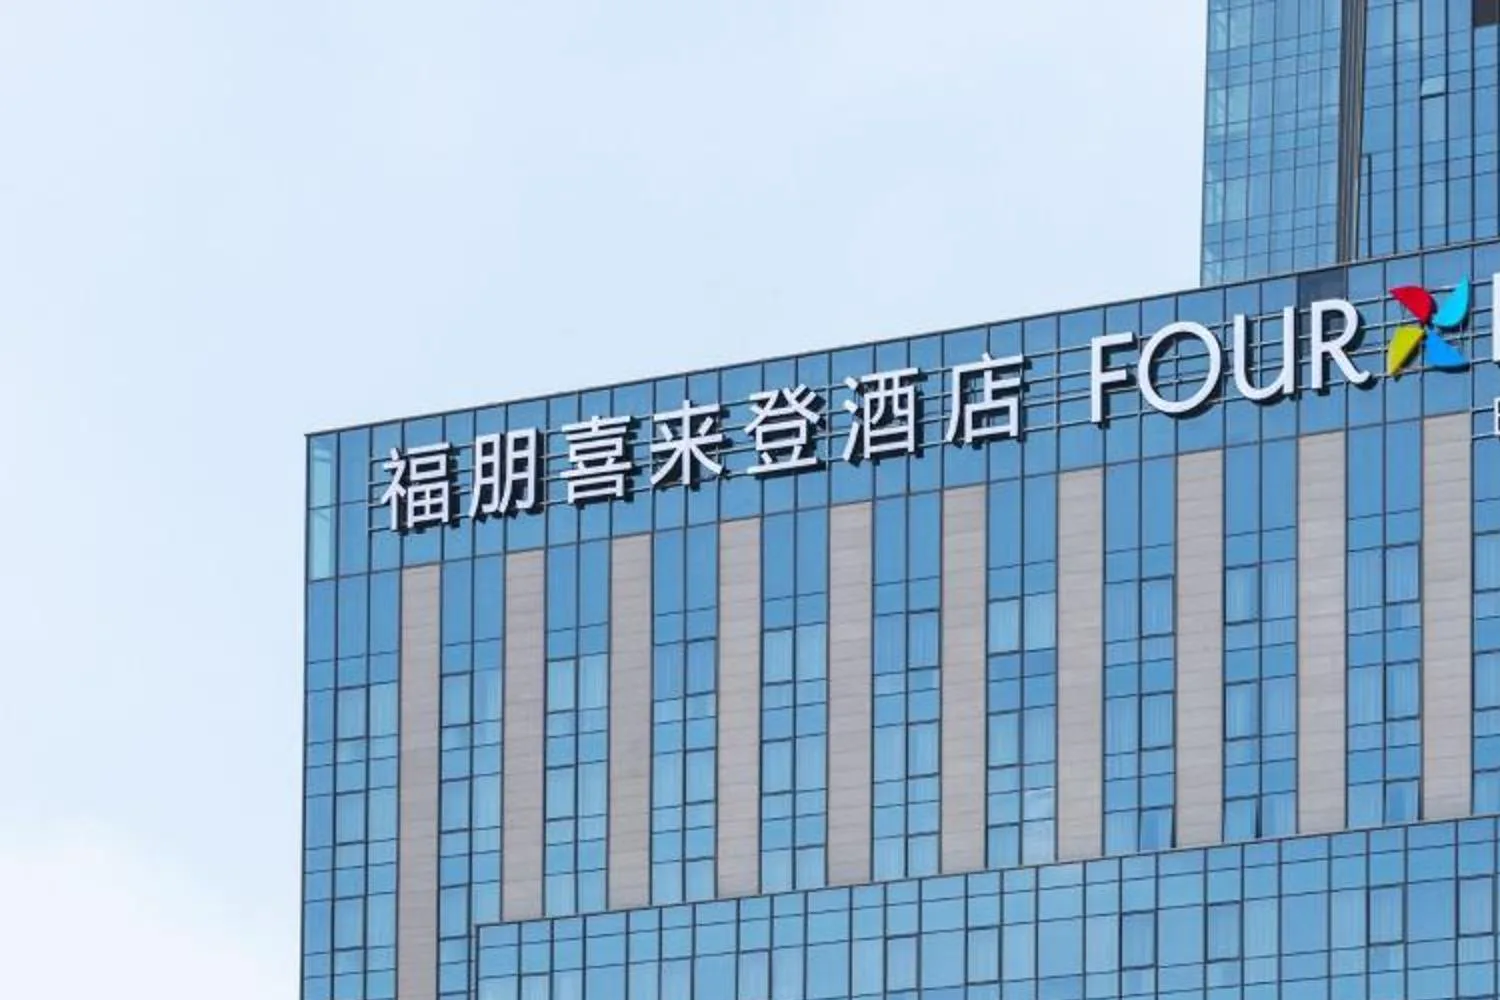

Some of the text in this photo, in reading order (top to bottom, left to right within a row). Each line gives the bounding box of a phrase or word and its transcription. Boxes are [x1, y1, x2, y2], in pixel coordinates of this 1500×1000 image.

[1089, 298, 1369, 423] FOUR
[382, 353, 1026, 531] 福朋喜来登酒店
